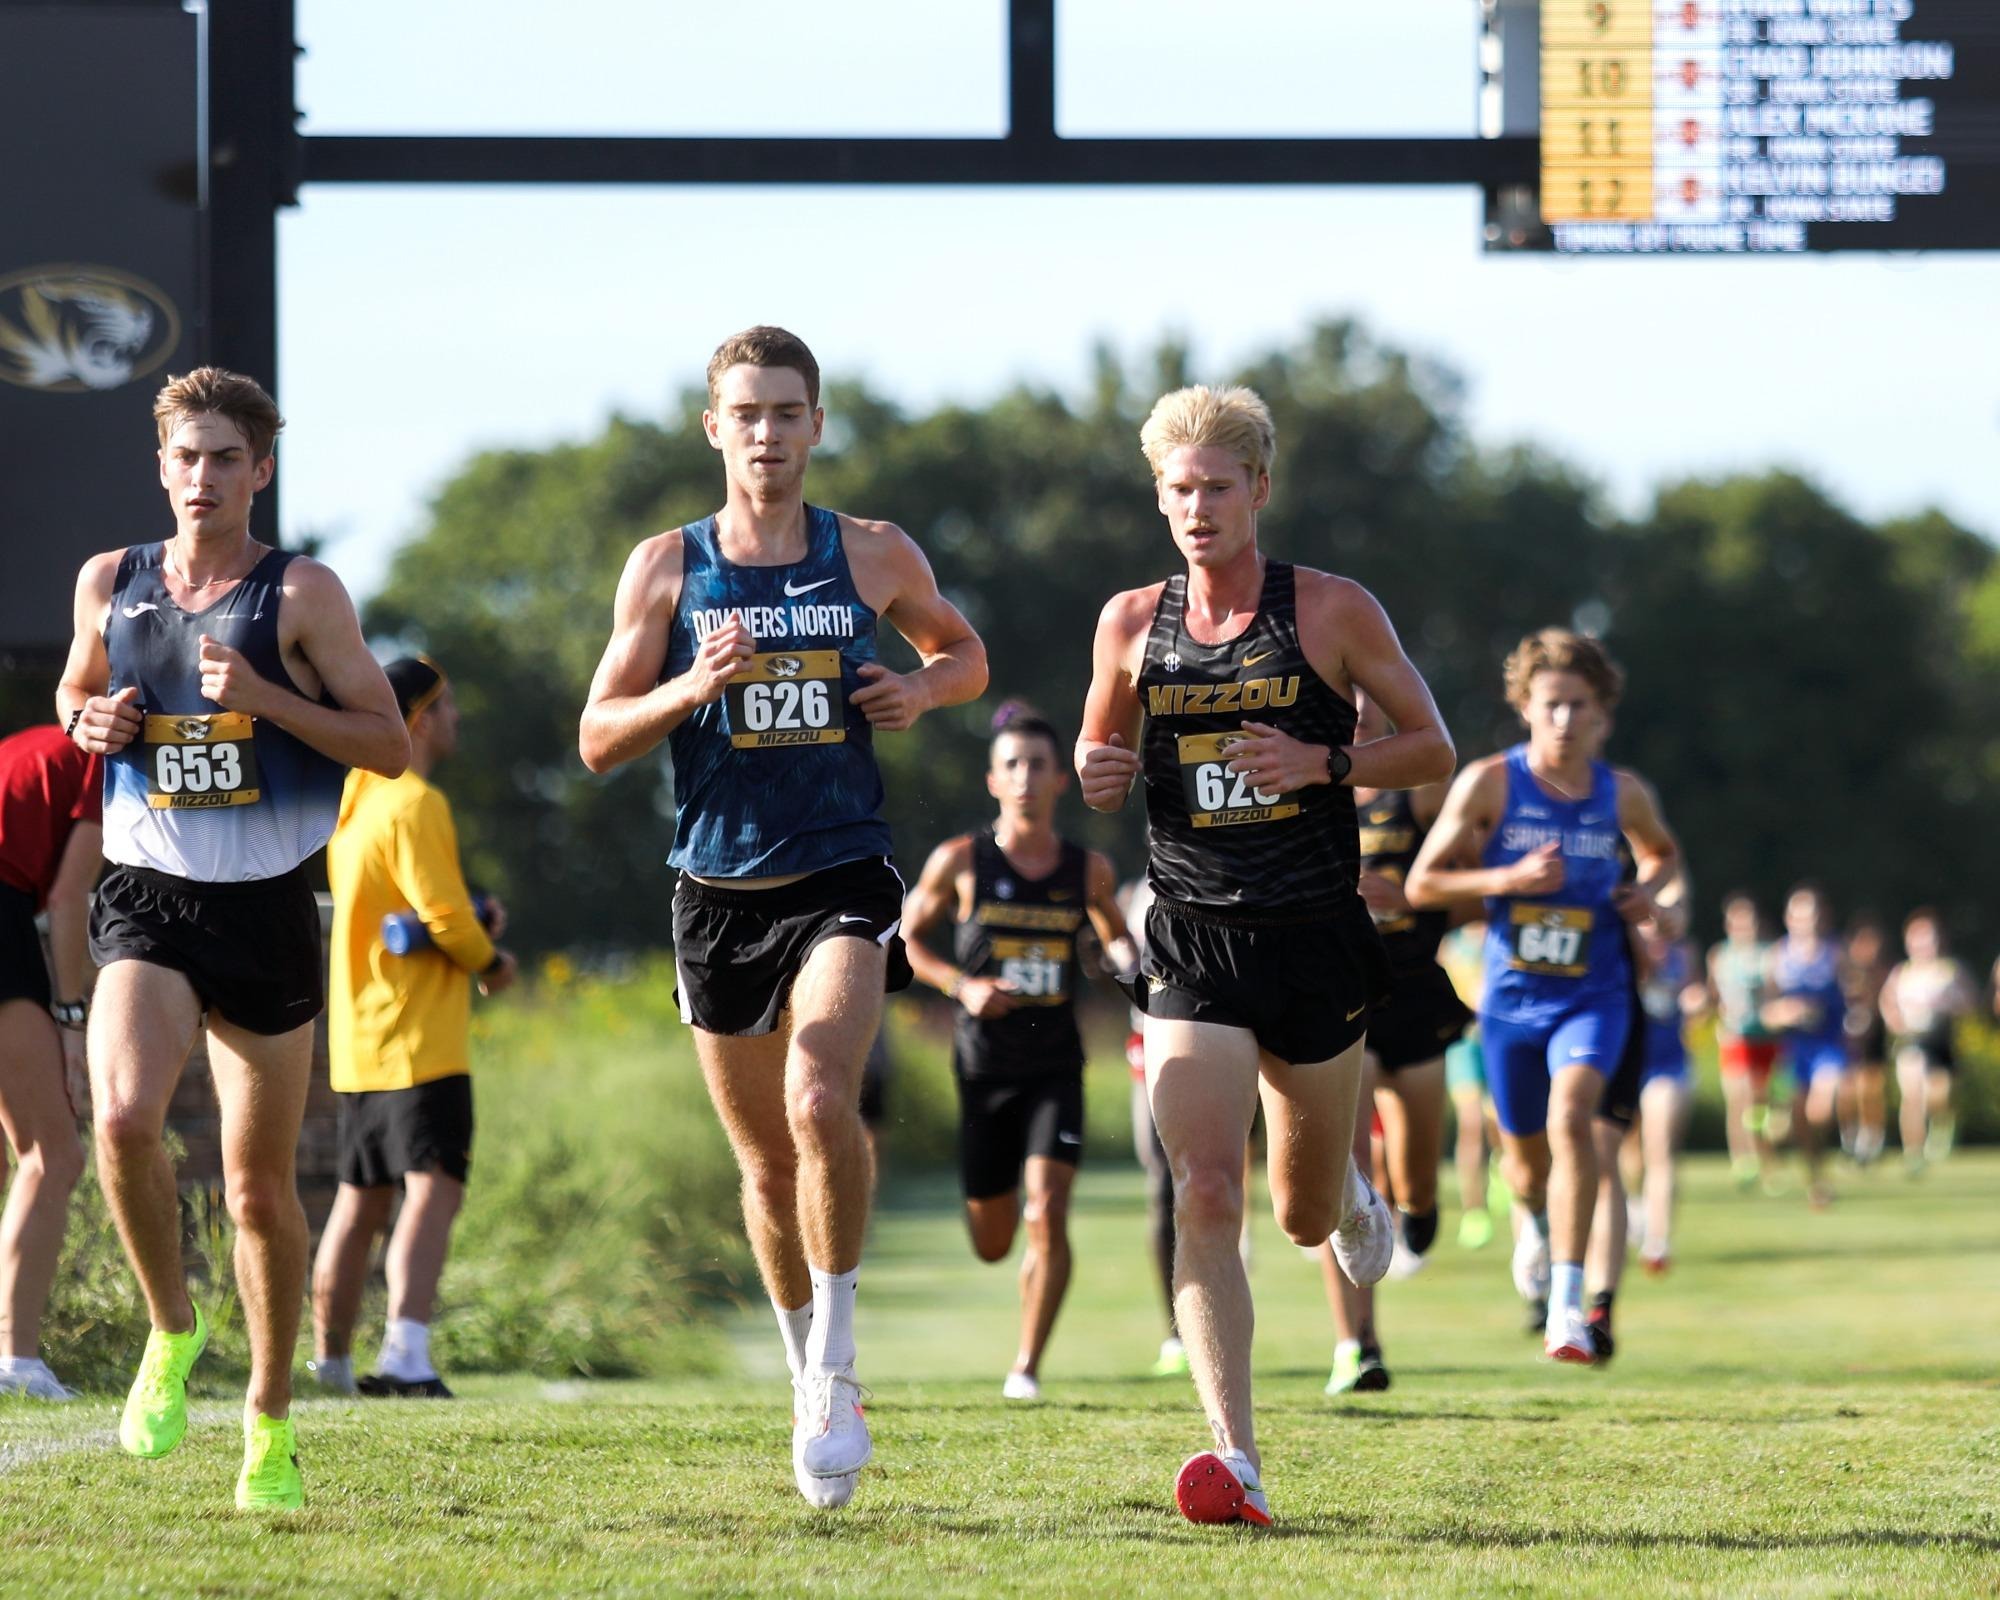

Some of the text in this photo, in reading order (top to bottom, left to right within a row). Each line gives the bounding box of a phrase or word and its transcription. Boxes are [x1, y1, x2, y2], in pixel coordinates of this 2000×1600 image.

[1577, 58, 1627, 98] 10
[1577, 117, 1620, 158] 11
[1577, 177, 1622, 217] 12
[791, 605, 853, 637] NORTH
[1164, 652, 1181, 673] SEC
[743, 680, 830, 731] 626
[1148, 676, 1300, 716] MIZZOU
[757, 730, 821, 746] MIZZOU
[156, 742, 242, 793] 653
[1196, 763, 1280, 810] 62
[169, 793, 232, 808] MIZZOU
[1210, 808, 1272, 825] MIZZOU
[1518, 924, 1581, 965] 647
